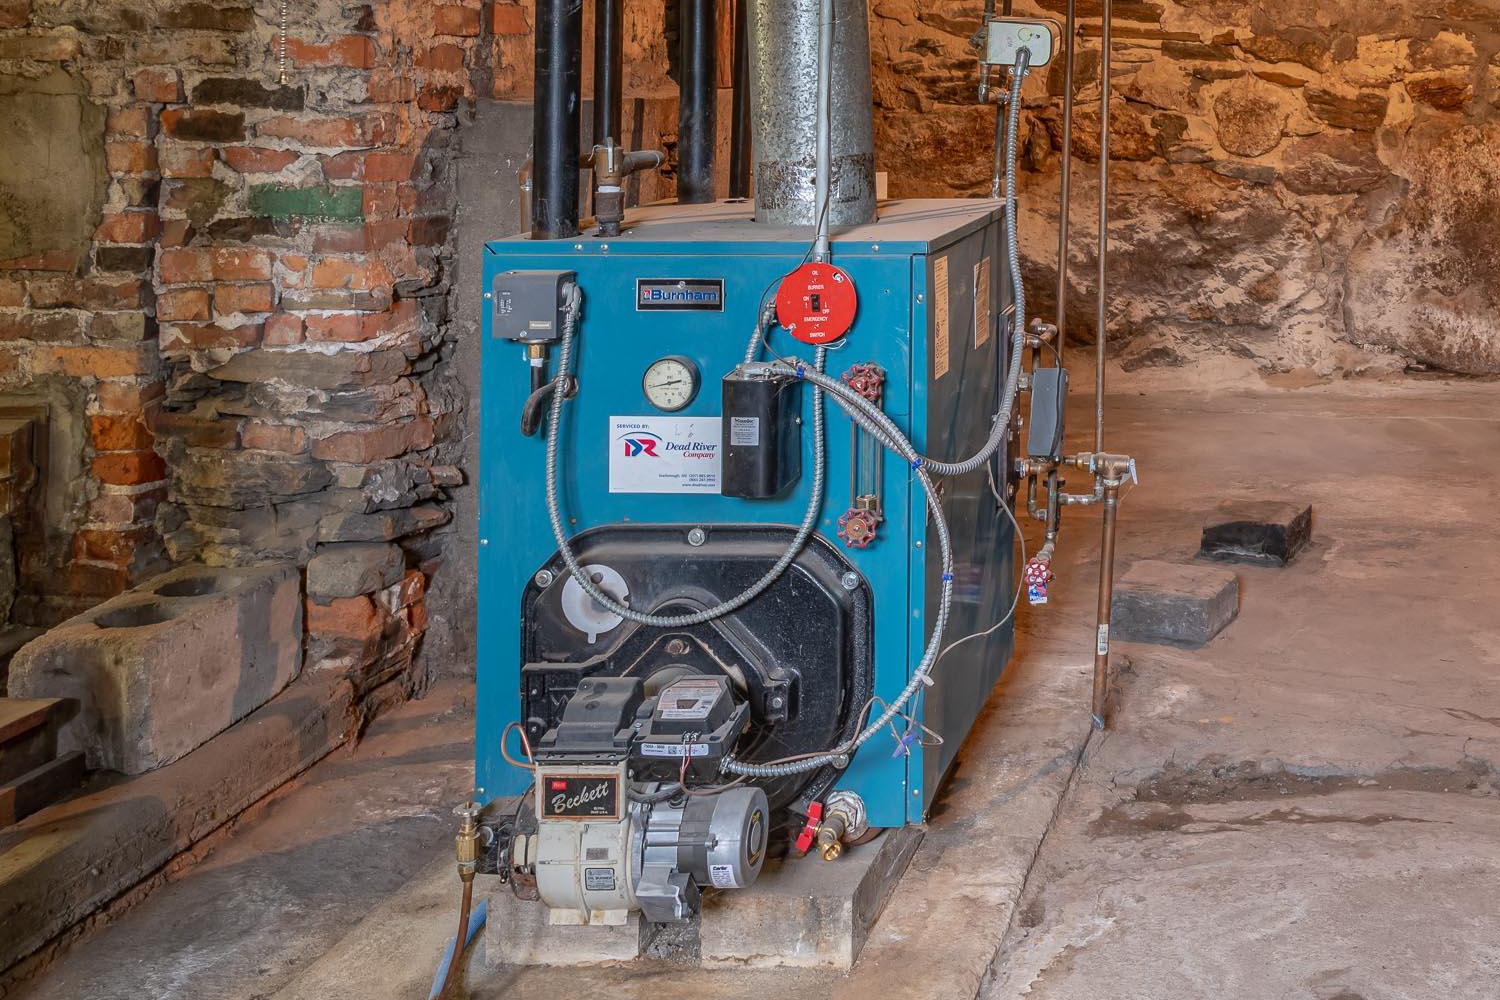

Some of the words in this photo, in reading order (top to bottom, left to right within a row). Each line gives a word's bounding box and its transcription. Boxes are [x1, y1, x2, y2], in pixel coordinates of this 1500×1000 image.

[651, 289, 717, 301] Burnham
[665, 441, 691, 451] Dead
[691, 441, 718, 451] River
[682, 450, 716, 459] Company
[551, 780, 609, 813] Beckett
